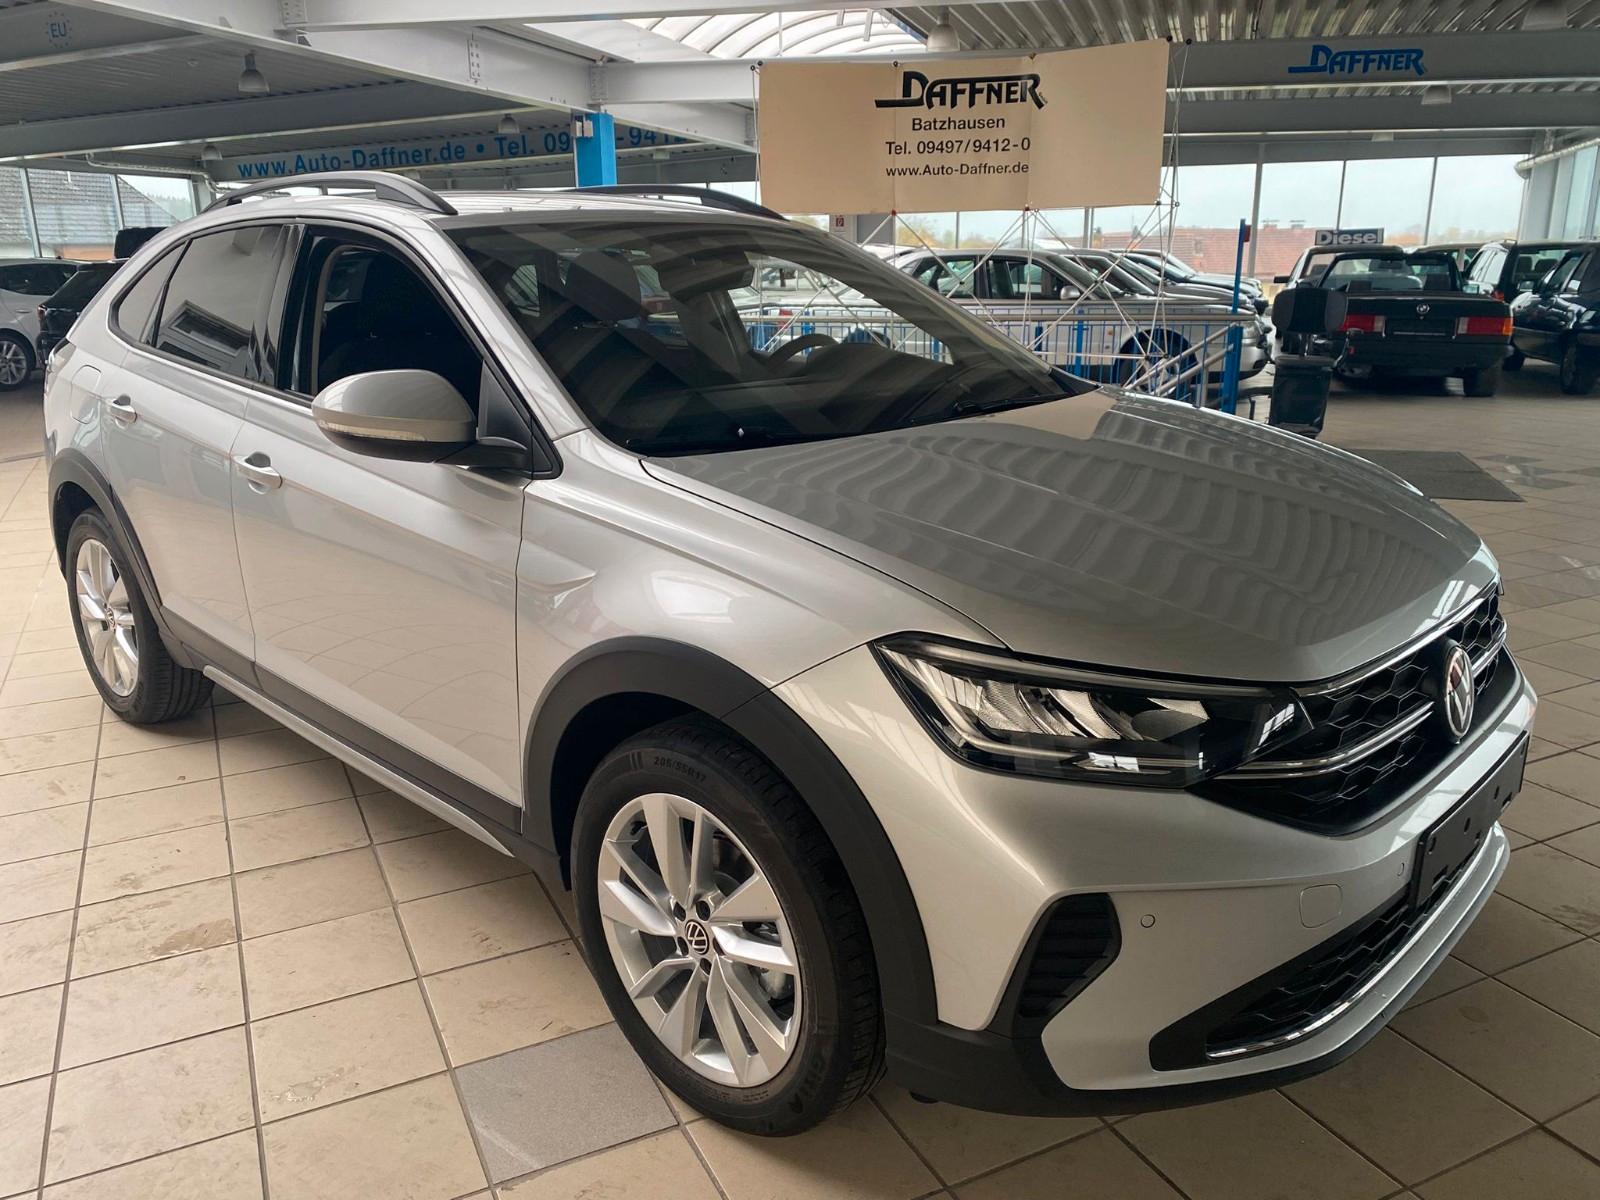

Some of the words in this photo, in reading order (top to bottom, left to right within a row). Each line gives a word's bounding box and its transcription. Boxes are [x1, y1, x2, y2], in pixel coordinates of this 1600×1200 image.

[49, 22, 67, 38] EU
[1288, 44, 1425, 76] DAFFNER
[875, 71, 1045, 110] DAFFNER
[912, 117, 1006, 131] Batzhausen
[885, 141, 912, 155] Tel.
[917, 137, 1031, 154] 09497/9412-0
[238, 142, 465, 178] www.Auto-Daffner.de
[494, 135, 535, 156] Tel.
[885, 162, 1030, 176] www.Auto-Daffner.de
[1316, 230, 1381, 245] Diesel
